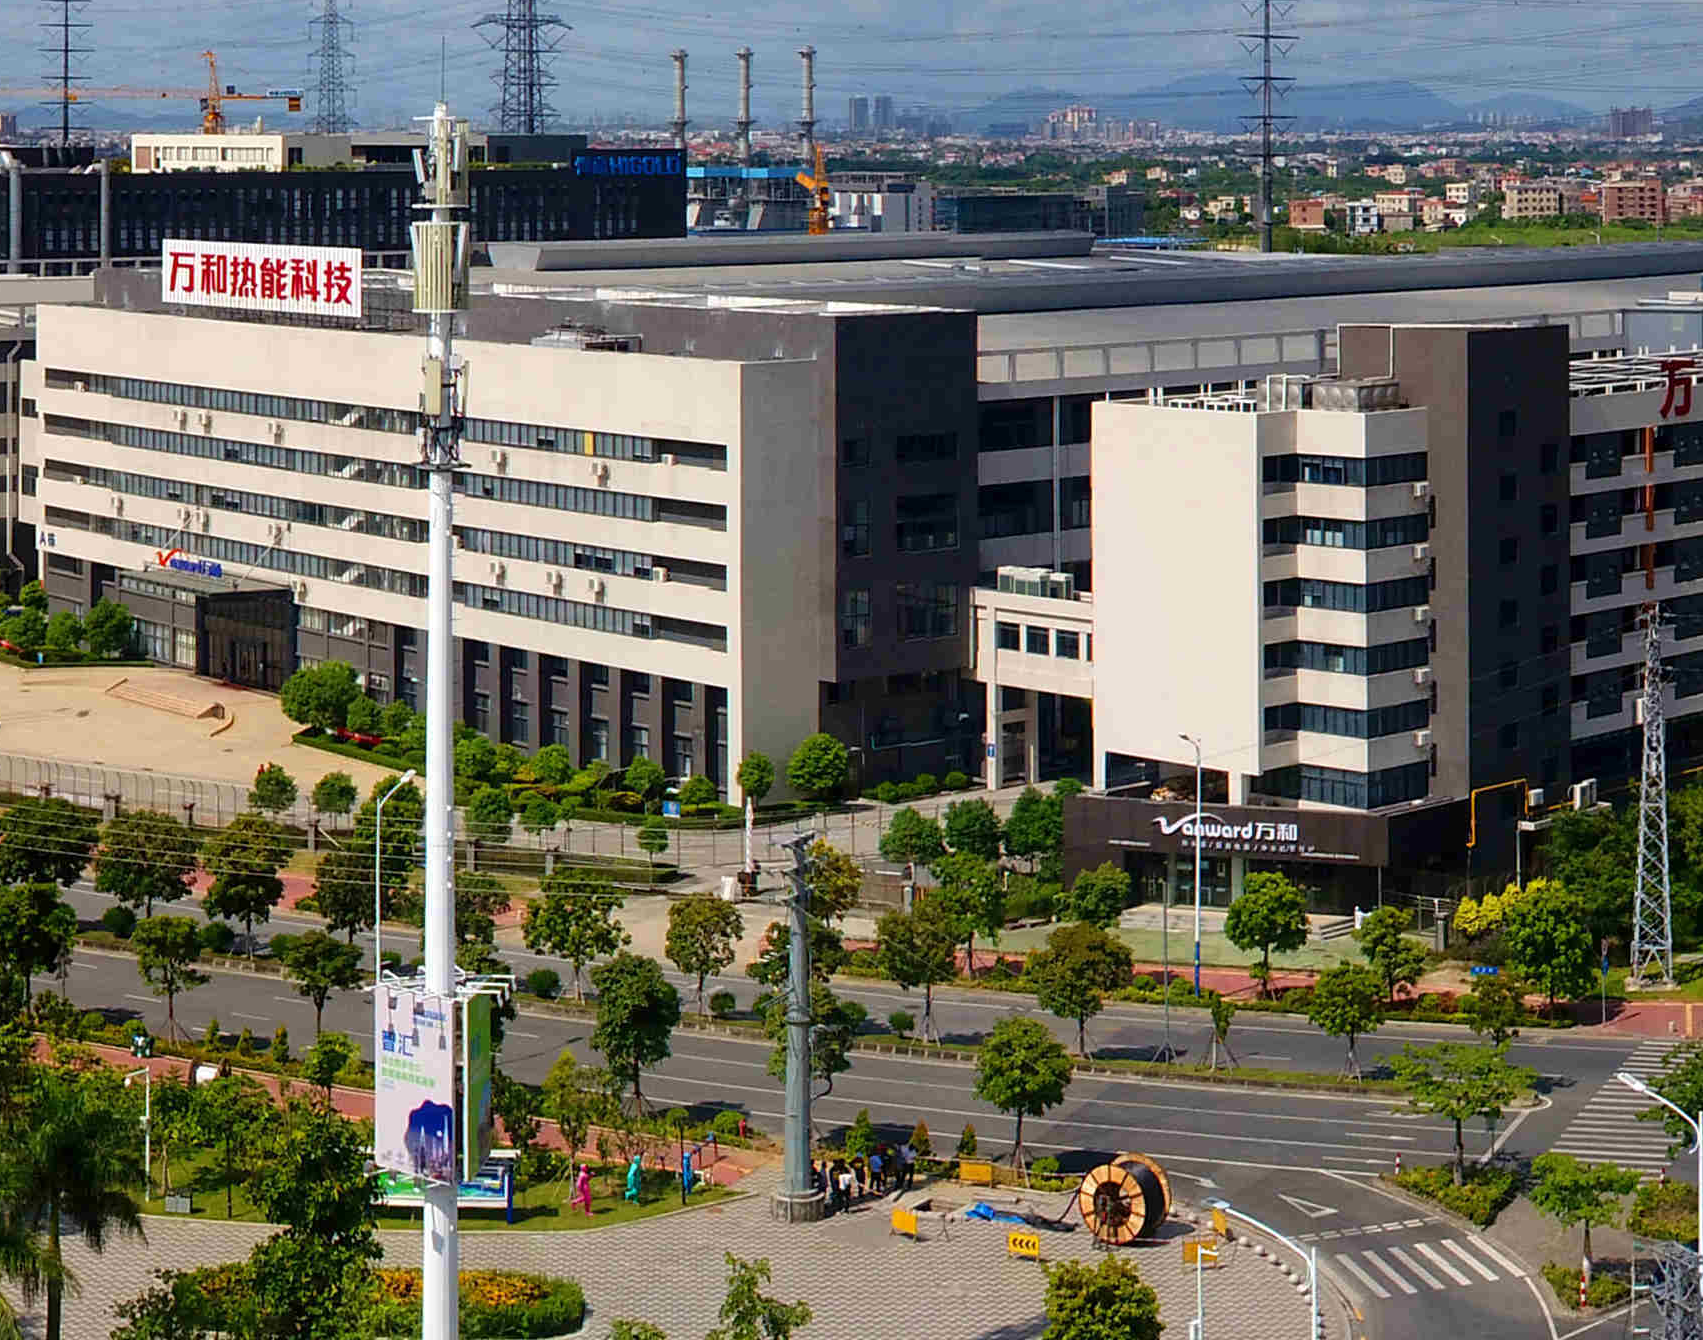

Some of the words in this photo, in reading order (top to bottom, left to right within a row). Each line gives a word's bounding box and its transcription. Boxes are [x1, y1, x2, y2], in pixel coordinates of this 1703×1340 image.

[169, 251, 353, 305] 万和热能科技
[1152, 812, 1253, 839] Vanward
[1254, 821, 1298, 841] 万和
